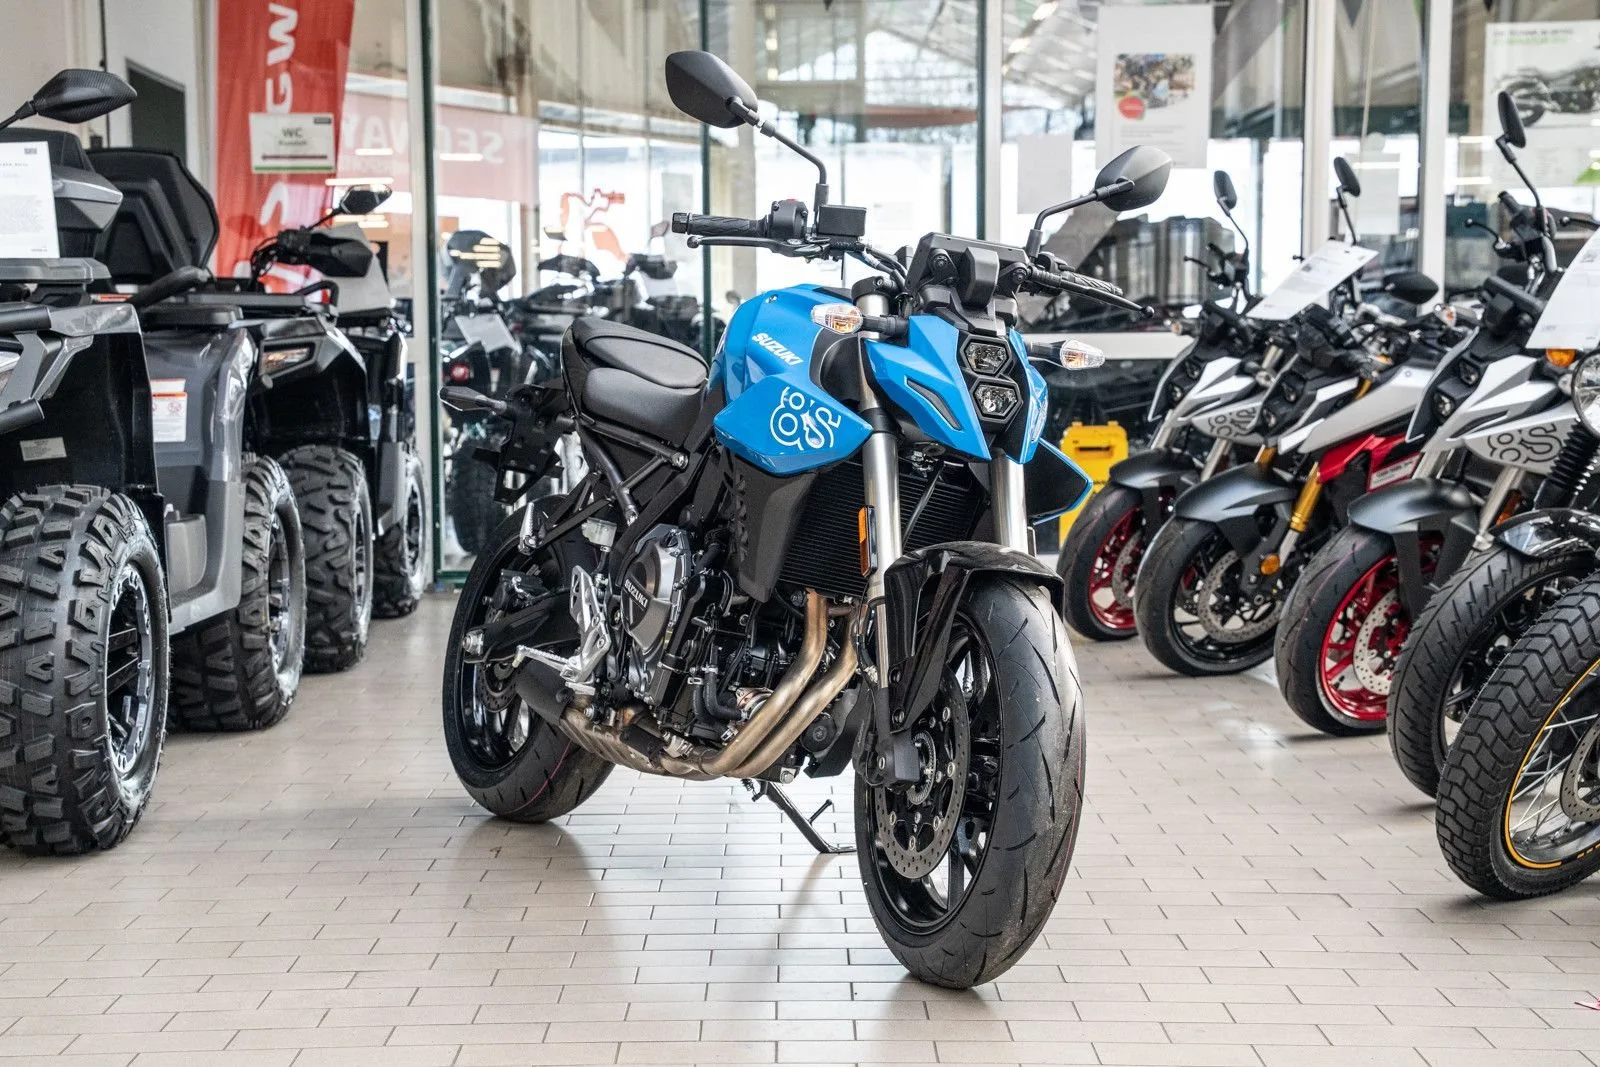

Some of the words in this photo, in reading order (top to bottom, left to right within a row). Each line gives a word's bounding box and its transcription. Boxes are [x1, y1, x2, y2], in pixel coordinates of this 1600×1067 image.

[281, 127, 304, 138] WC
[752, 333, 804, 366] SUZUKI
[624, 579, 648, 608] SUZUKI
